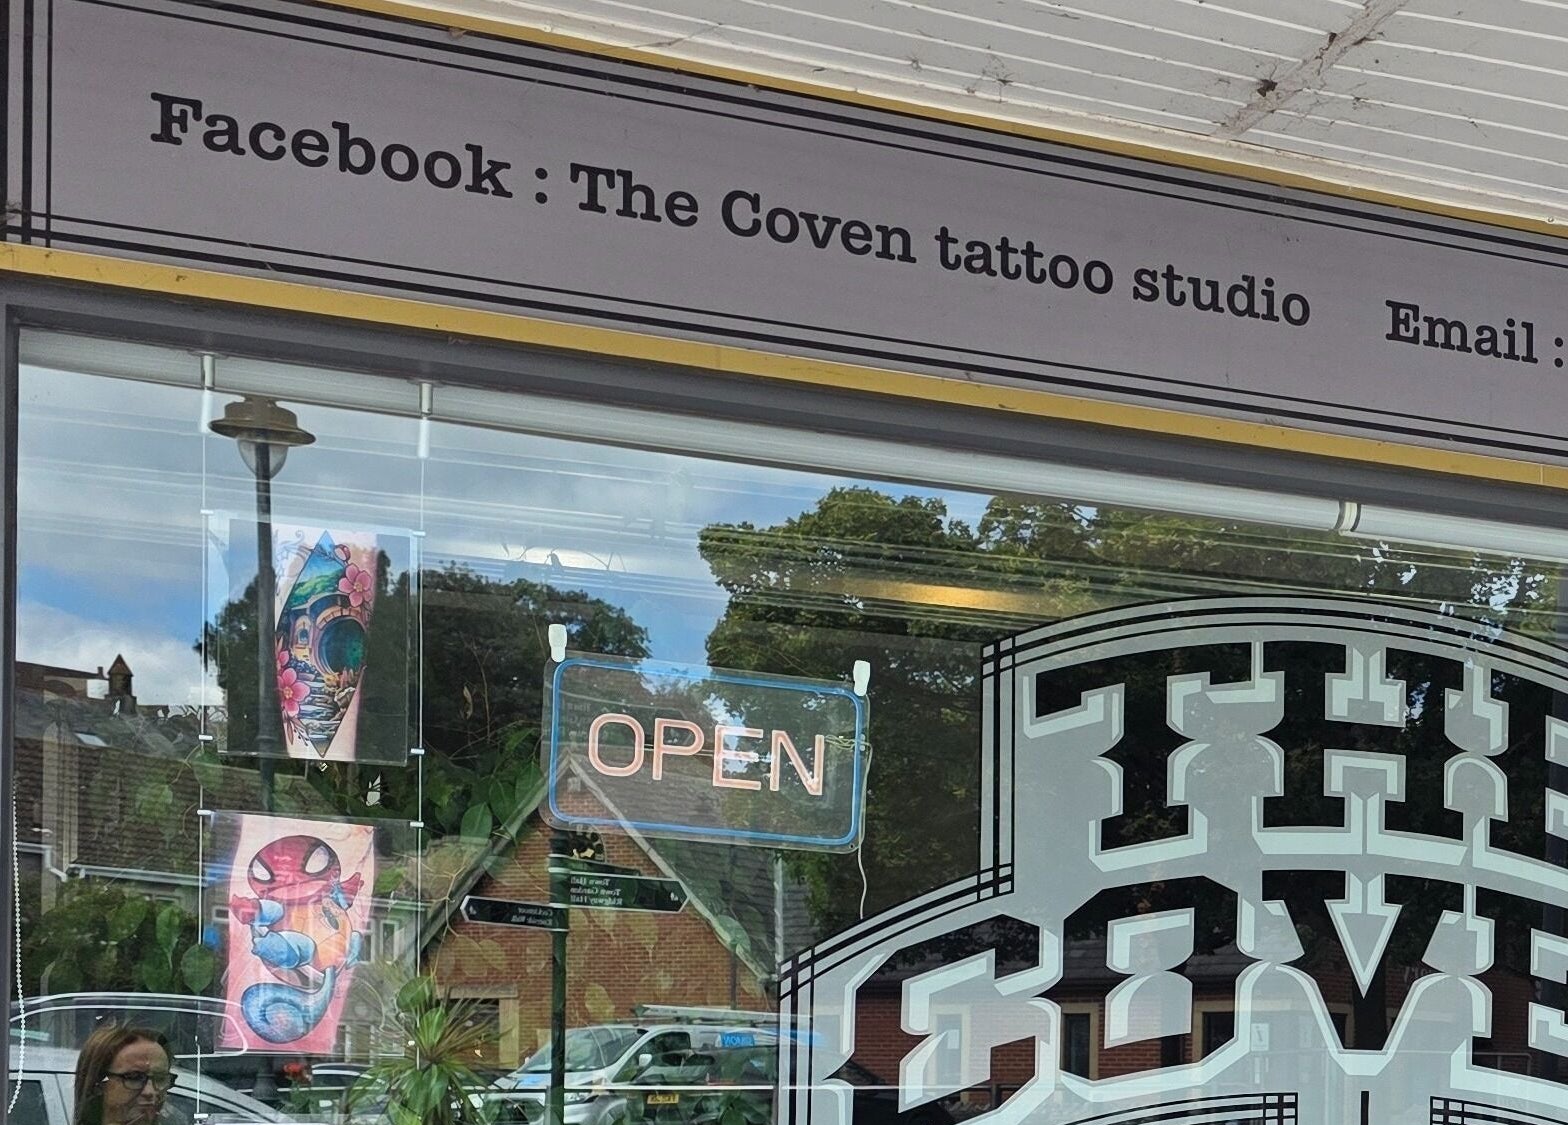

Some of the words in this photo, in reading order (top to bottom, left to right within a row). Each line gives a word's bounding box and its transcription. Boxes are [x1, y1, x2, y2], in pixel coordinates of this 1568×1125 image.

[150, 92, 513, 199] Facebook
[569, 162, 699, 228] The
[721, 189, 917, 264] Coven
[934, 225, 1114, 295] tattoo
[1132, 263, 1311, 327] studio
[1385, 299, 1539, 364] Email
[588, 713, 825, 796] OPEN
